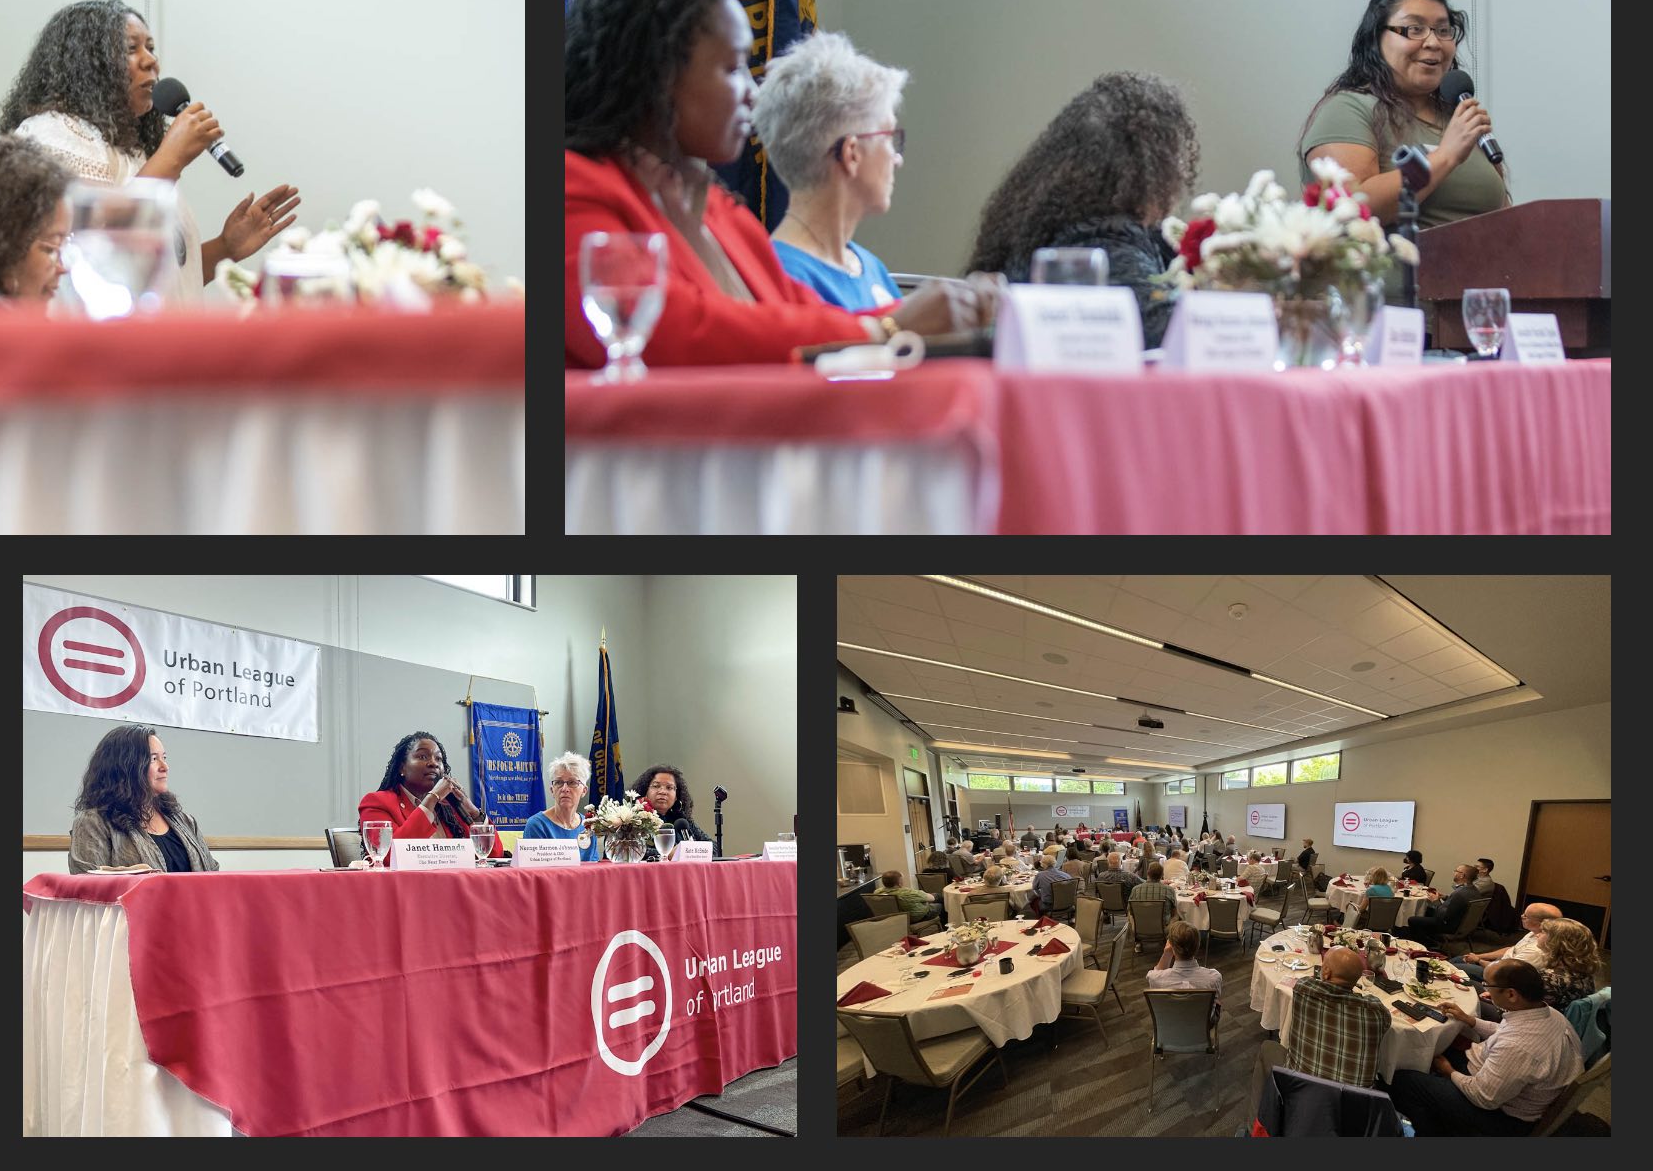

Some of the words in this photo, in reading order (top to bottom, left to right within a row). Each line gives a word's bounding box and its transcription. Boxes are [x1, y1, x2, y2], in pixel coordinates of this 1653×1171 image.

[164, 649, 224, 675] Urban
[233, 661, 295, 687] League
[164, 678, 186, 695] of
[193, 680, 272, 708] Portland
[733, 945, 782, 969] League
[687, 990, 704, 1017] of
